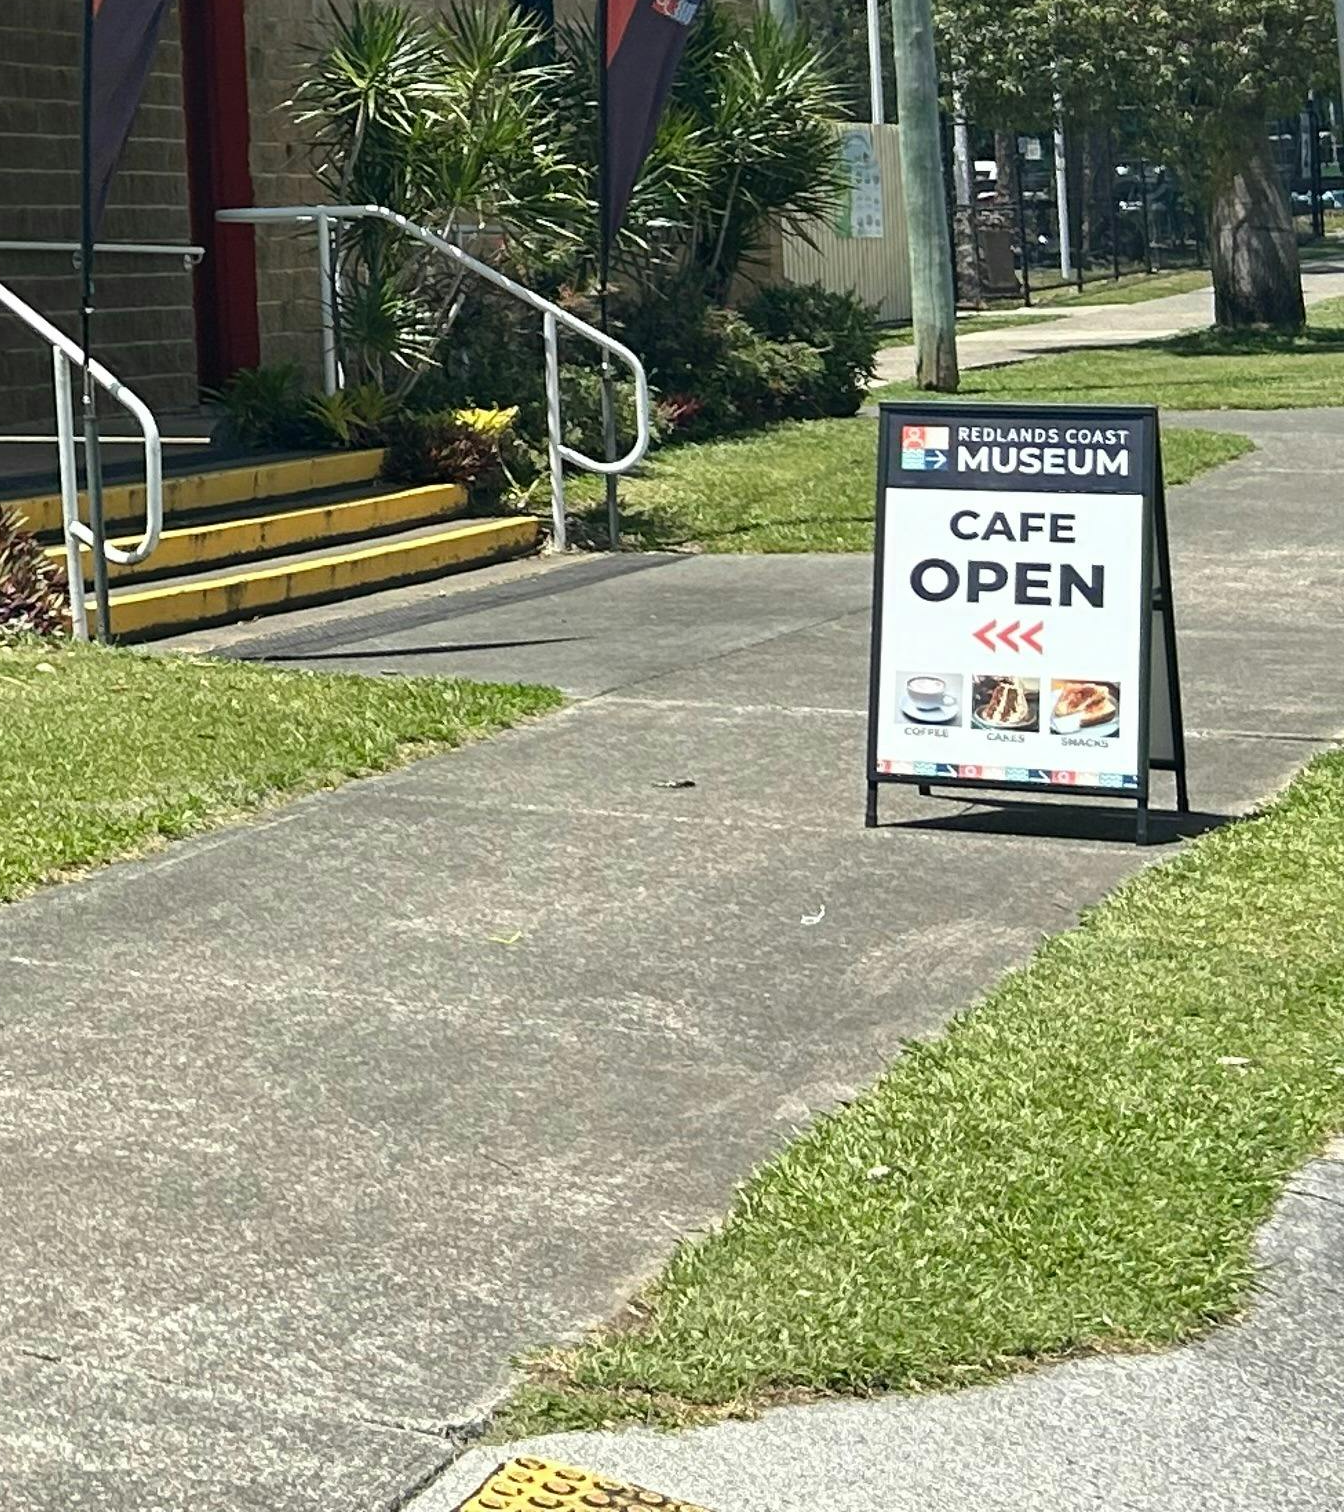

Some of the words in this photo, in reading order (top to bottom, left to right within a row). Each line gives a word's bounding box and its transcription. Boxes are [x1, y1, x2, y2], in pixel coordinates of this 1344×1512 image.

[957, 426, 1058, 443] REDLANDS
[1065, 429, 1129, 445] COAST
[957, 446, 1129, 476] MUSEUM
[949, 509, 1077, 544] CAFE
[909, 557, 1105, 608] OPEN
